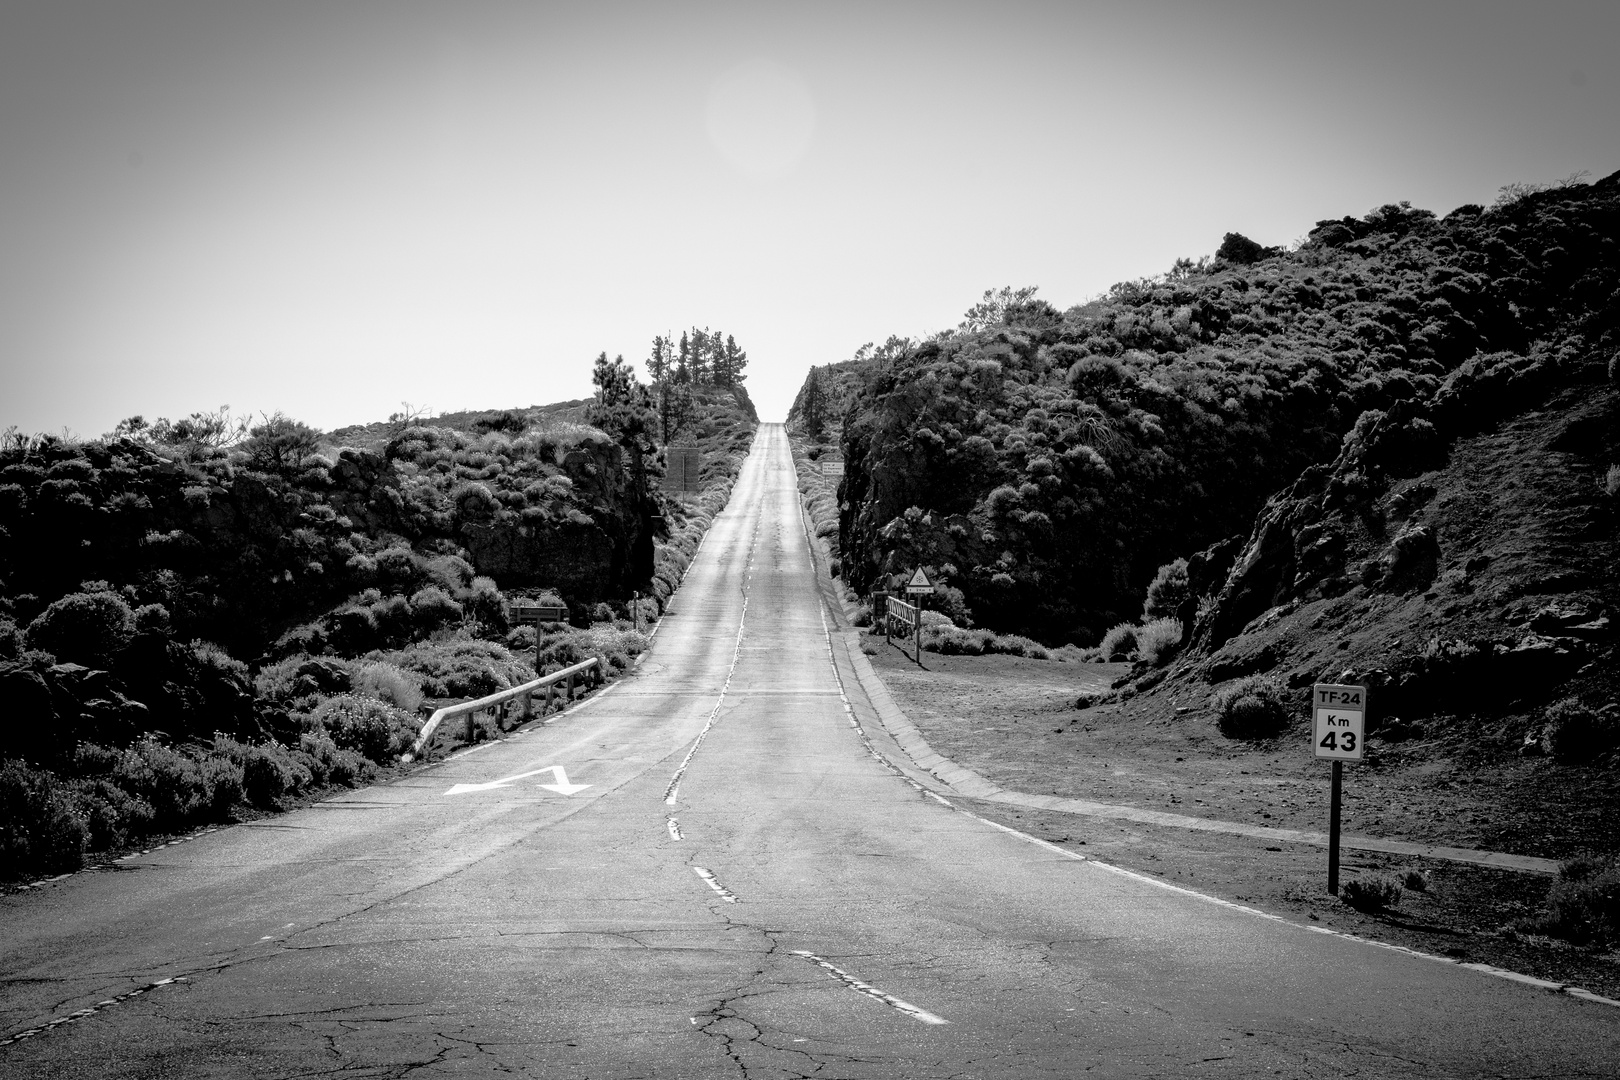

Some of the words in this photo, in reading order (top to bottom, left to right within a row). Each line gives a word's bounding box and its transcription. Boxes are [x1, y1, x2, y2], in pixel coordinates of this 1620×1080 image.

[1319, 691, 1361, 705] TF-24
[1327, 714, 1350, 727] Km
[1319, 731, 1357, 752] 43
